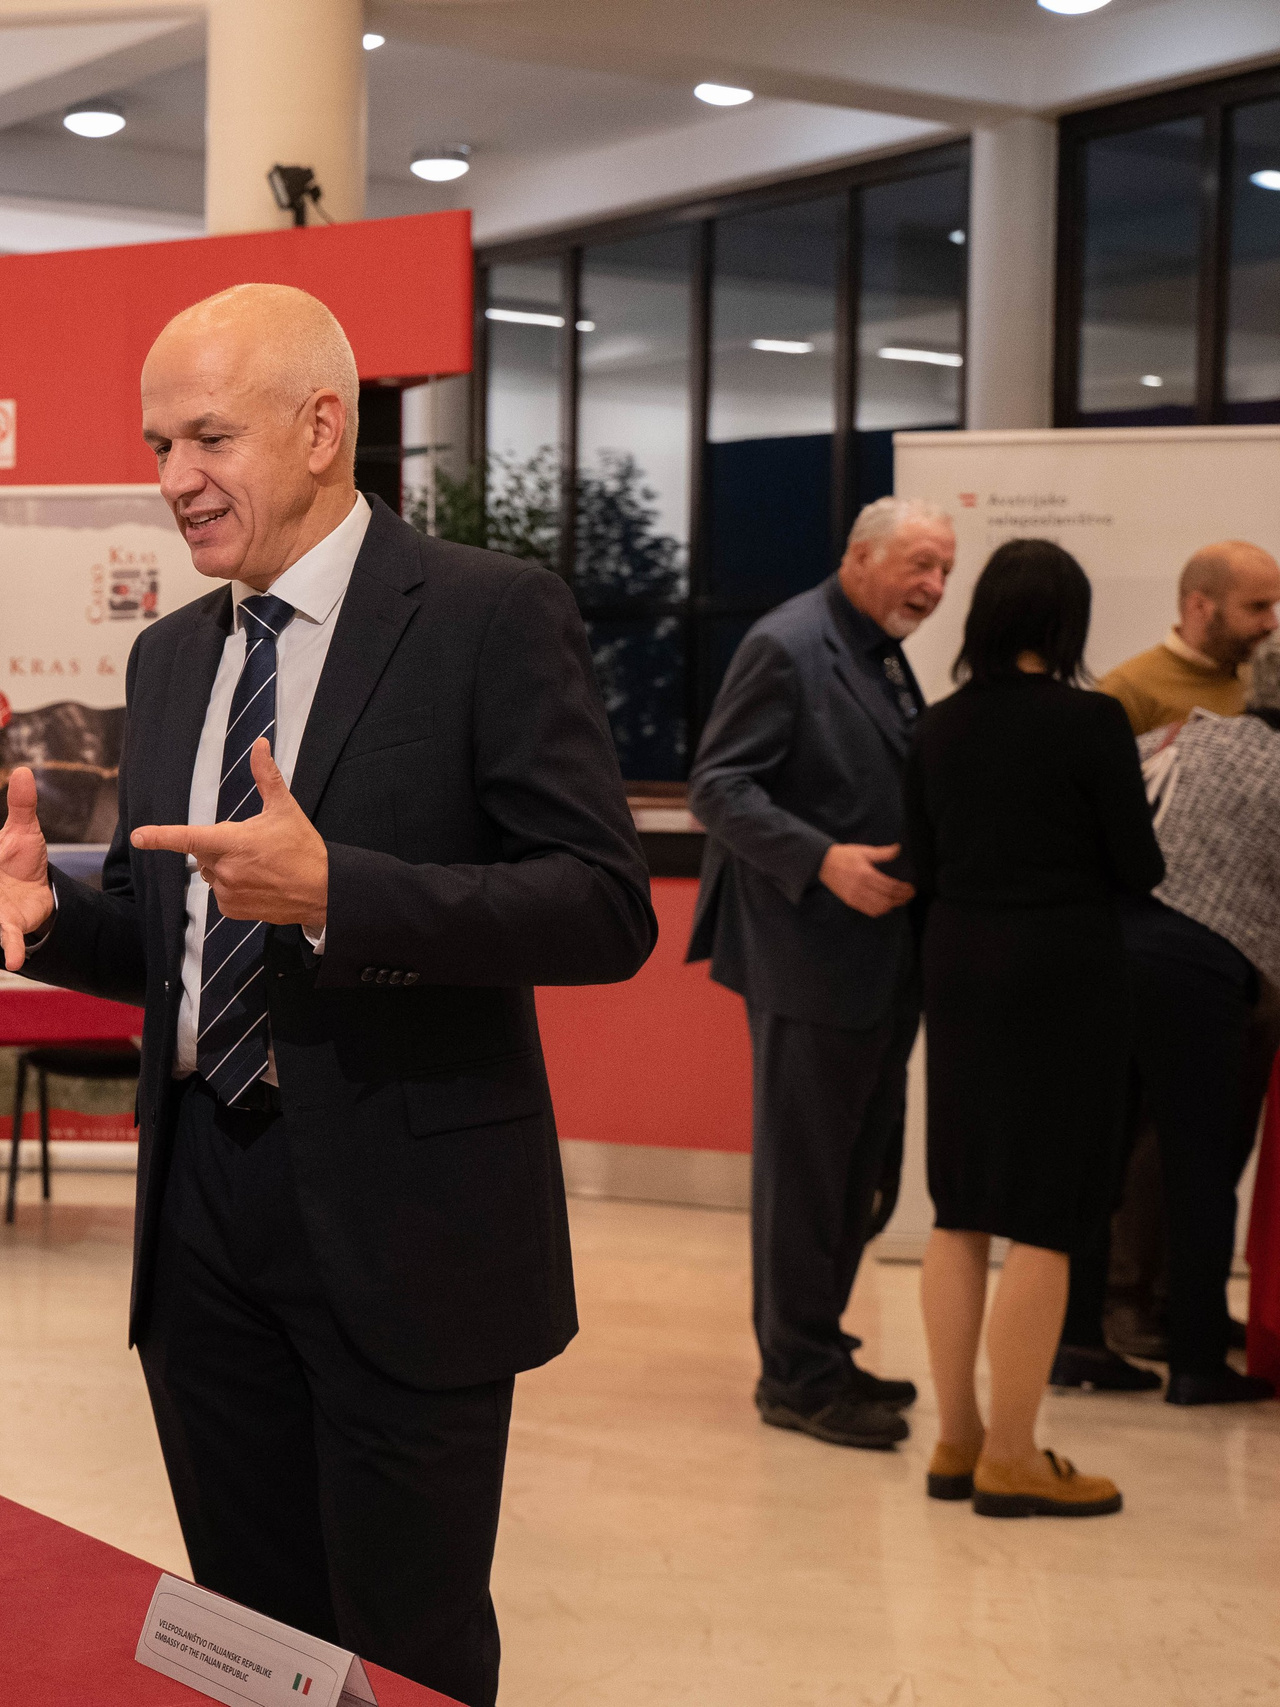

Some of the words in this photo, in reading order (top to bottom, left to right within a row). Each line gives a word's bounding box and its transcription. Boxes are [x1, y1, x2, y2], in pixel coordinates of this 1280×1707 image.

[9, 657, 81, 676] KRAS
[97, 655, 117, 676] &
[154, 1631, 181, 1649] EMBASSY
[180, 1643, 189, 1653] OF
[188, 1646, 200, 1659] THE
[199, 1652, 222, 1669] ITALIAN
[221, 1663, 249, 1682] REPUBLIC
[159, 1619, 208, 1648] VELEPOSLANIŠTVO
[241, 1657, 272, 1679] REPUBLIKE
